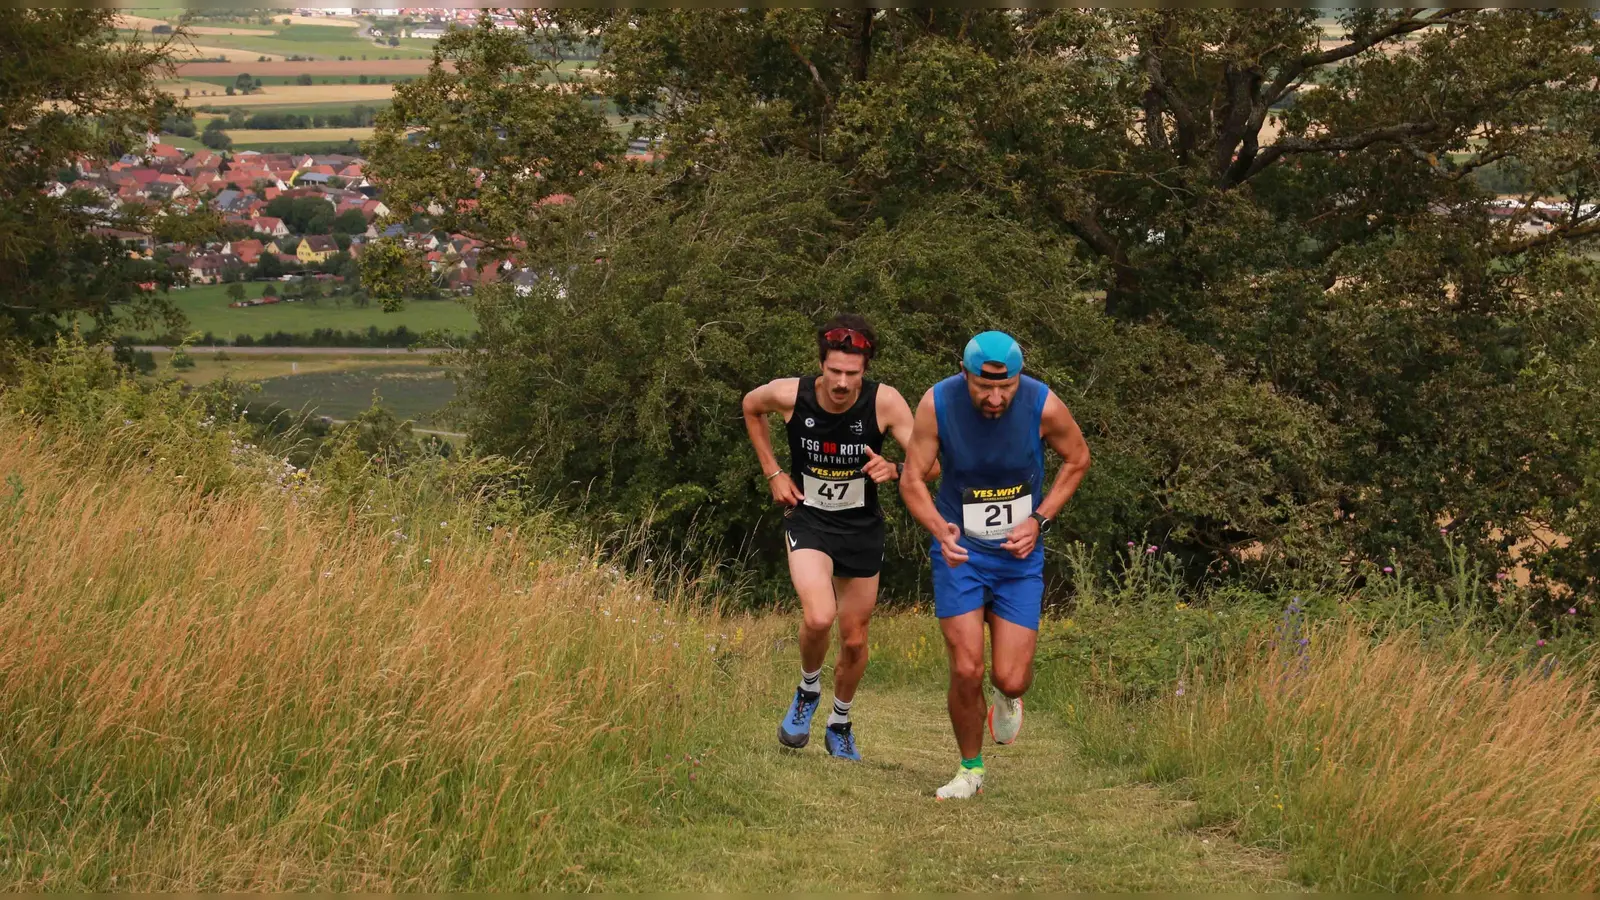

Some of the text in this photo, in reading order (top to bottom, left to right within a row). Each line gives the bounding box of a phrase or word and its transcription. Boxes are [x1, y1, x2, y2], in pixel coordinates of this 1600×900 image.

[800, 437, 820, 452] TSG
[840, 443, 867, 455] ROTH
[807, 452, 860, 464] TRIATHLON
[811, 467, 855, 477] YES.WHY
[818, 482, 850, 500] 47
[973, 484, 1023, 498] YES.WHY
[985, 504, 1013, 527] 21
